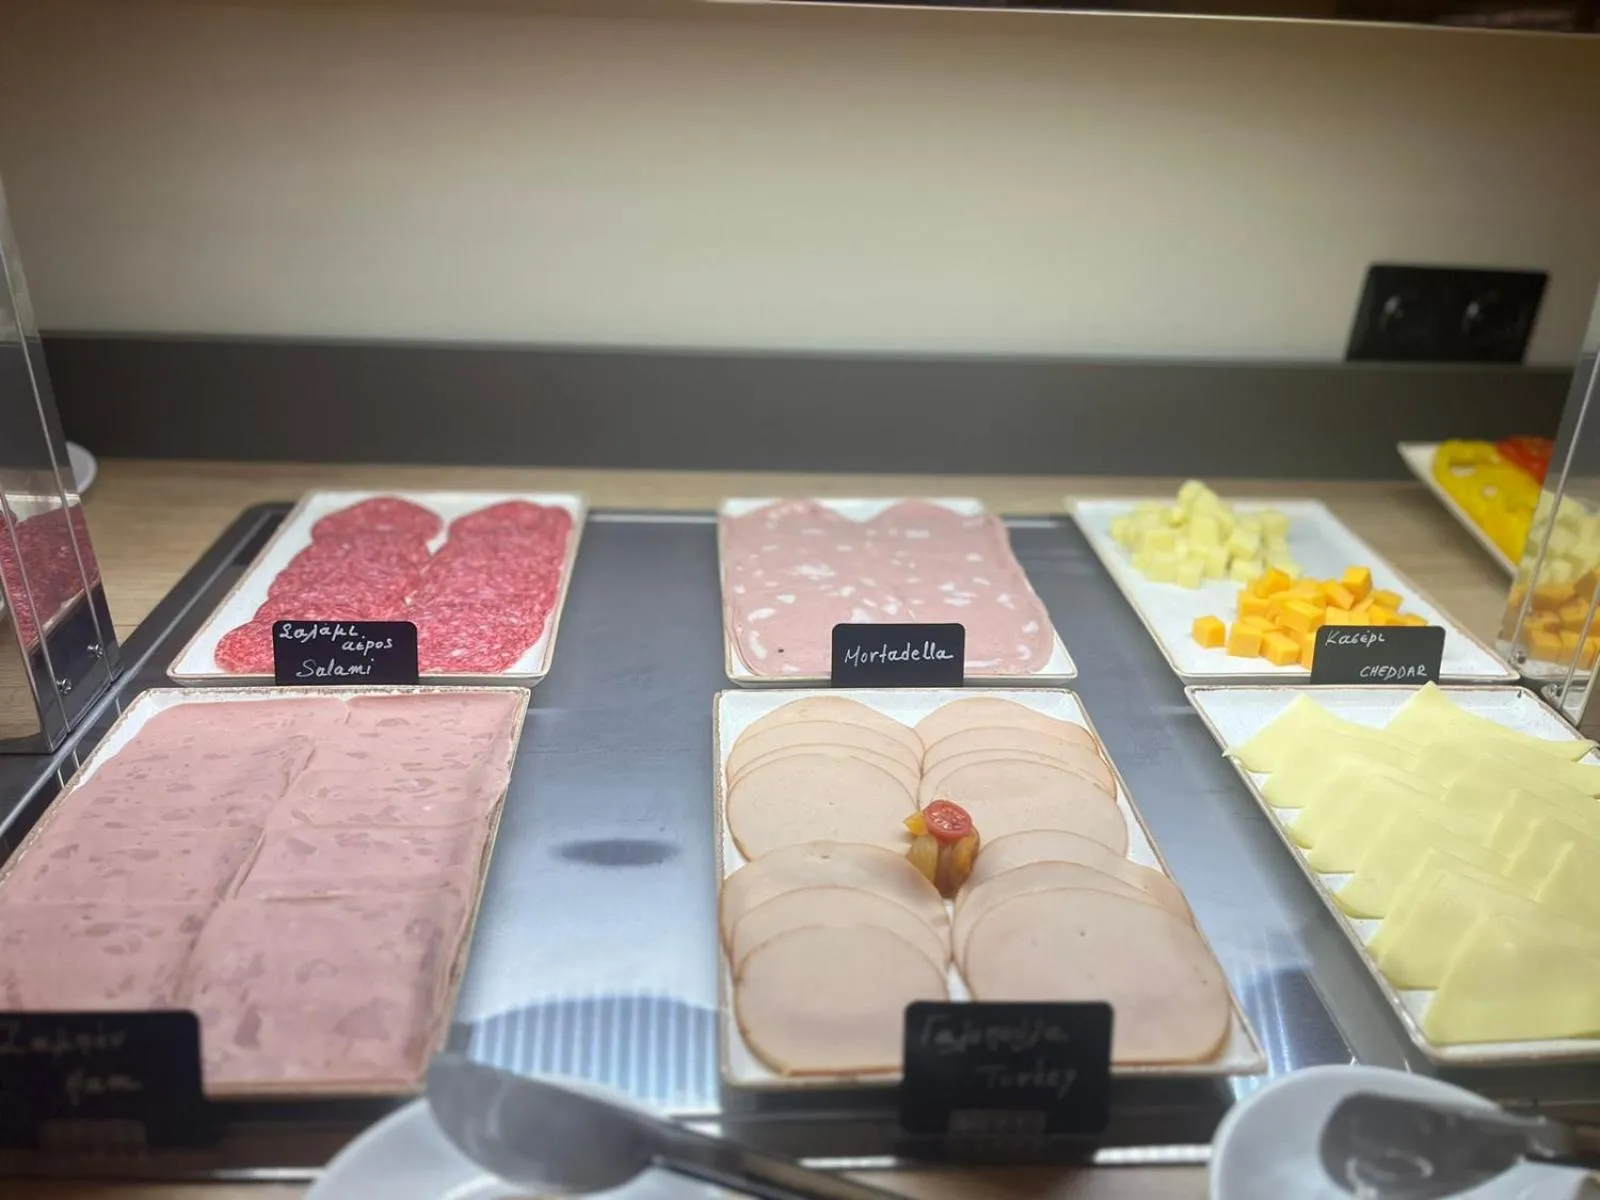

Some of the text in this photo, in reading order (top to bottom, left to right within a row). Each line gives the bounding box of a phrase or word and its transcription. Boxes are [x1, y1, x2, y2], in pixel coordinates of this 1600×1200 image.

[844, 641, 954, 667] Mortadella
[295, 658, 375, 677] Salami
[1360, 664, 1428, 680] CHEDDAR
